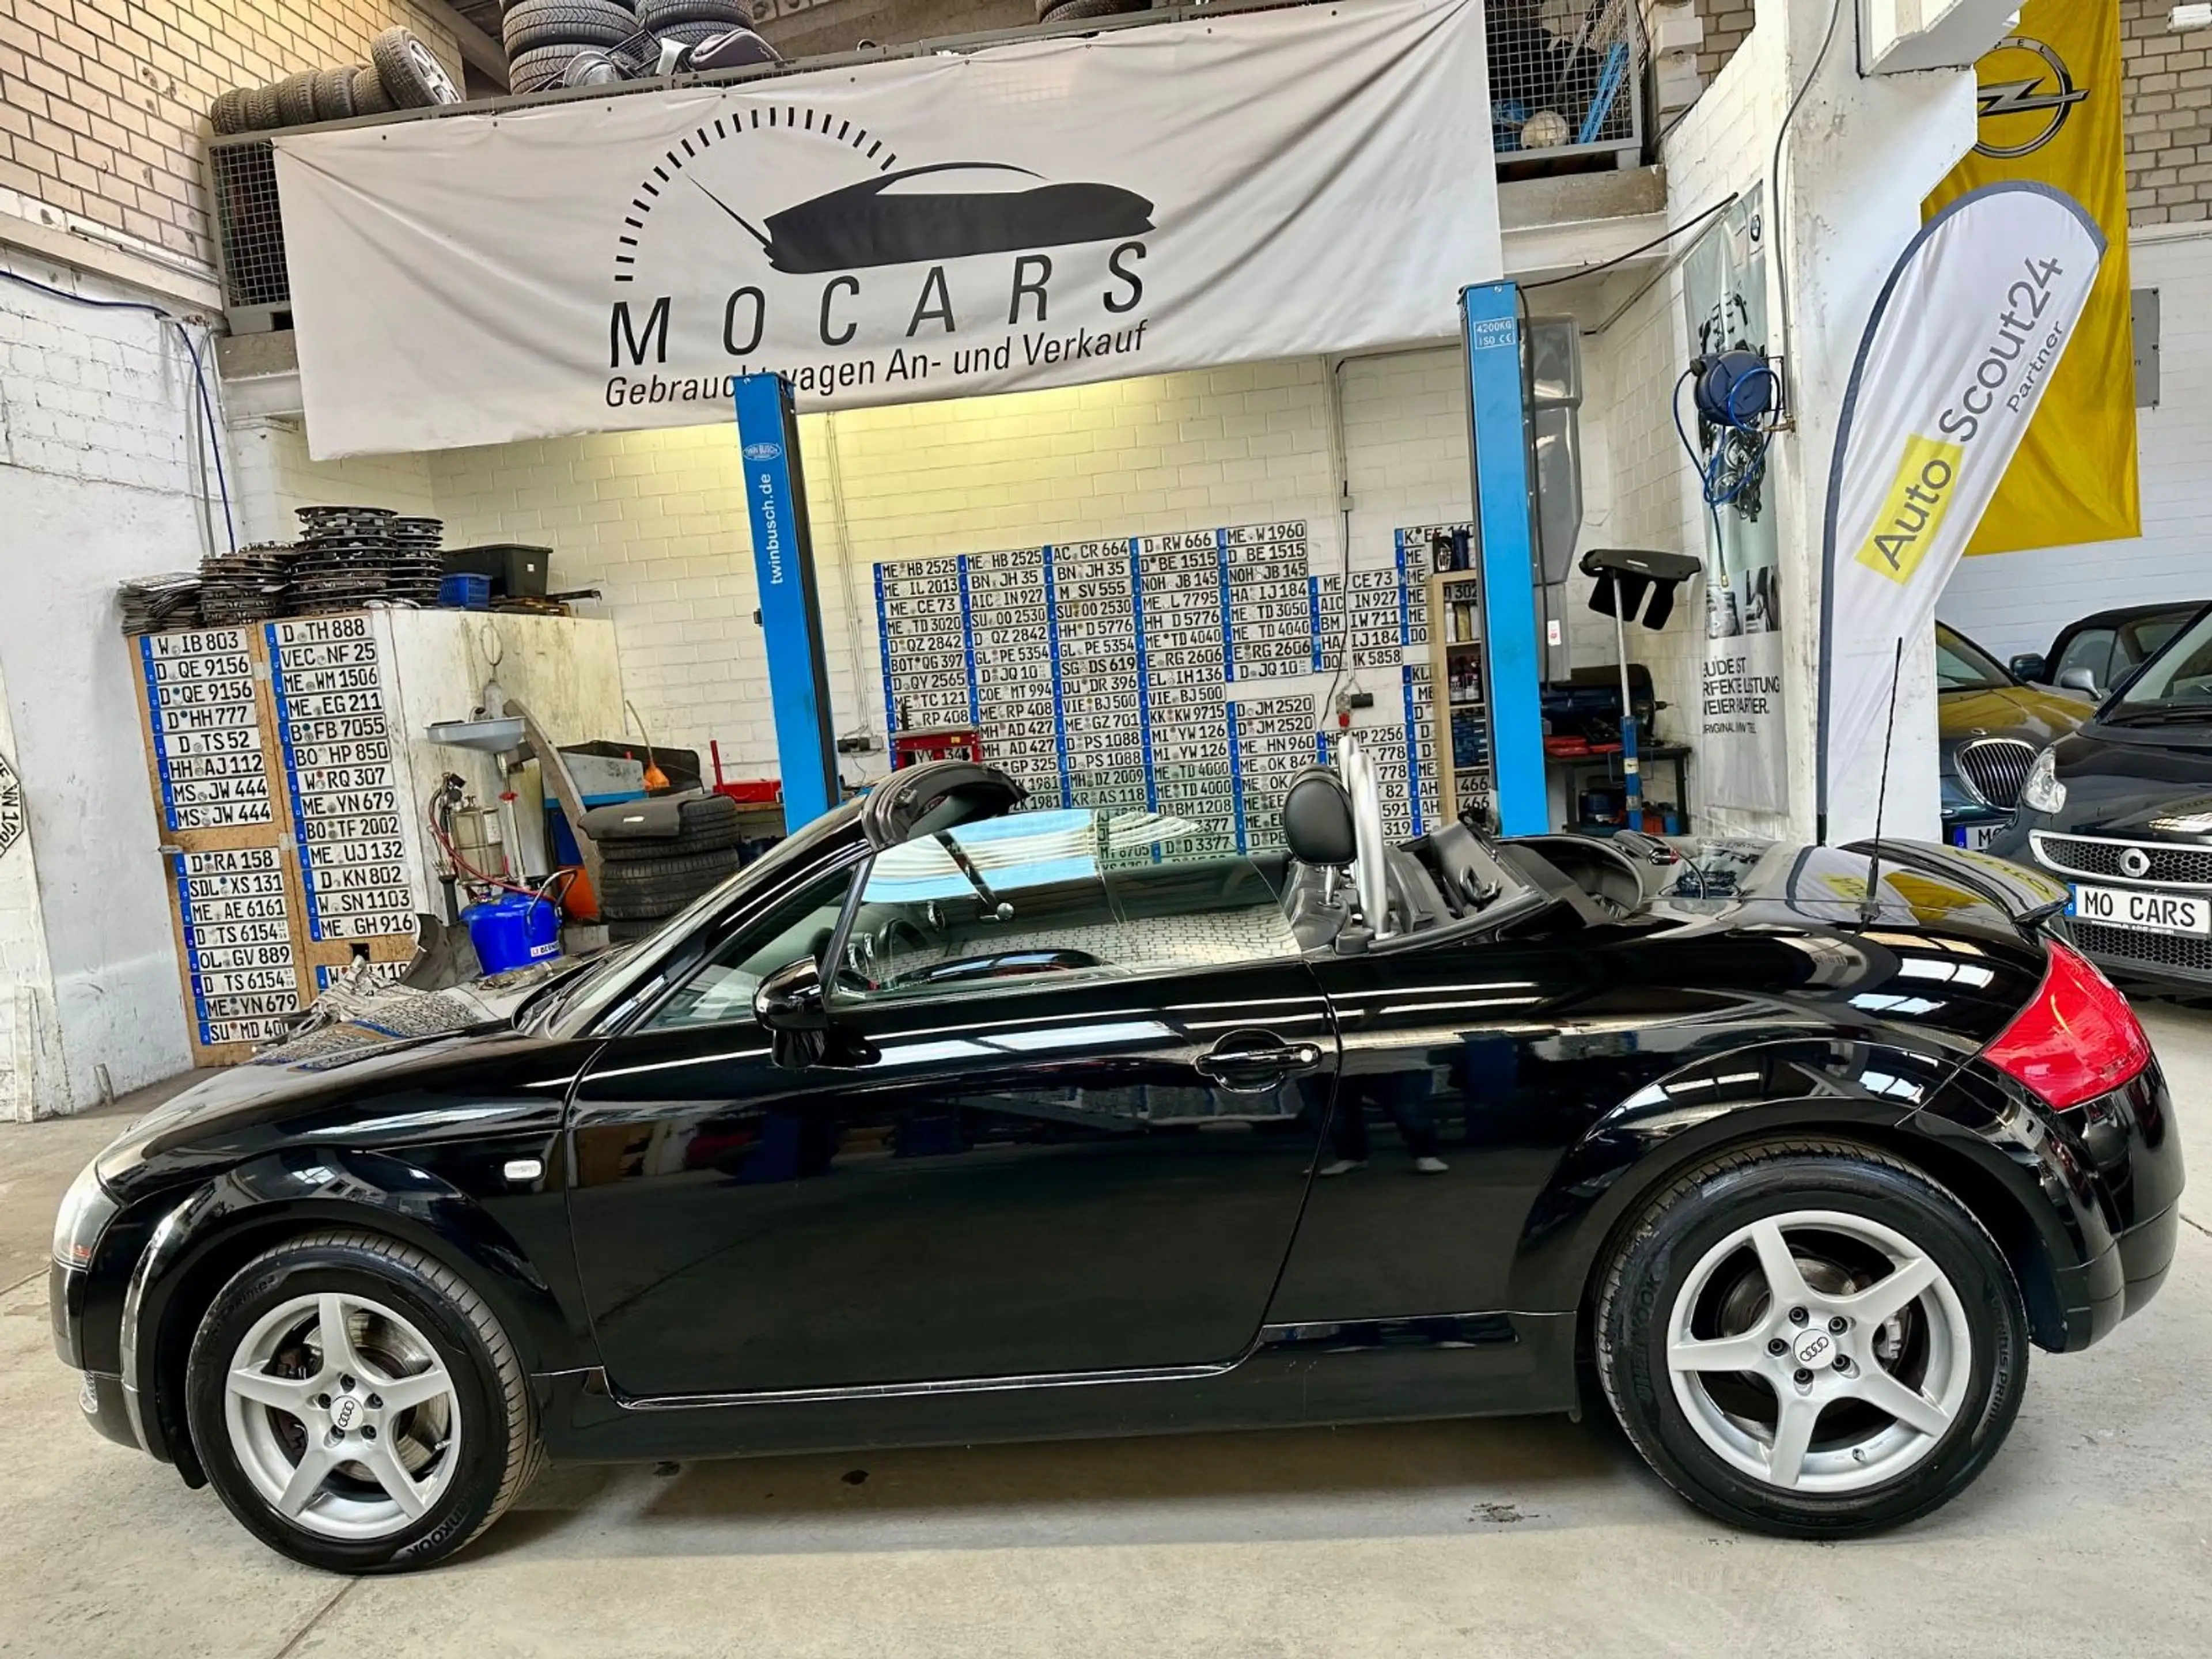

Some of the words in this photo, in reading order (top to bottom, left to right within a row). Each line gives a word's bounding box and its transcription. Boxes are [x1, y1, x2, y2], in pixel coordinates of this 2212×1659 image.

[1477, 321, 1512, 334] 4200KG
[886, 349, 941, 382] An-
[955, 336, 1010, 374] und
[1023, 319, 1149, 365] Verkauf
[1940, 255, 2063, 442] Scout24
[2007, 320, 2063, 413] Partner
[1873, 460, 1952, 571] Auto
[759, 474, 783, 584] twinbusch.de
[1054, 546, 1071, 561] AC
[1080, 544, 1099, 558] CR
[1103, 541, 1127, 556] 664
[1144, 539, 1153, 553] D
[1162, 536, 1181, 551] RW
[1185, 533, 1211, 548] 666
[1228, 550, 1237, 563] D
[1247, 547, 1266, 562] BE
[1269, 543, 1305, 559] 1515
[883, 565, 898, 578] ME
[907, 562, 923, 576] HB
[926, 559, 956, 574] 2525
[884, 583, 900, 597] ME
[910, 582, 924, 594] IL
[927, 578, 957, 593] 2013
[1060, 586, 1069, 599] M
[1078, 583, 1096, 597] SV
[1099, 580, 1126, 596] 555
[1142, 577, 1166, 591] NOH
[1175, 574, 1191, 588] JB
[1195, 571, 1217, 586] 145
[1324, 577, 1341, 592] ME
[1353, 574, 1372, 588] CE
[1374, 571, 1392, 586] 73
[972, 593, 993, 608] AIC
[1005, 591, 1018, 605] IN
[1021, 589, 1042, 603] 927
[1143, 596, 1161, 611] ME
[1171, 594, 1180, 607] L
[1183, 590, 1218, 607] 7795
[1230, 588, 1249, 603] HA
[1259, 585, 1277, 600] IJ
[1280, 582, 1306, 598] 184
[891, 602, 908, 616] ME
[918, 600, 935, 613] CE
[938, 598, 955, 612] 73
[282, 625, 294, 642] D
[305, 621, 329, 640] TH
[332, 619, 365, 638] 888
[158, 638, 168, 654] W
[182, 635, 202, 653] IB
[206, 631, 238, 650] 803
[889, 641, 897, 653] D
[907, 638, 925, 652] QZ
[928, 635, 961, 650] 2842
[281, 649, 316, 668] VEC
[327, 645, 349, 664] NF
[354, 642, 375, 661] 25
[892, 658, 913, 672] BOT
[940, 654, 963, 668] 397
[975, 651, 991, 665] GL
[1000, 649, 1016, 662] PE
[1018, 646, 1048, 661] 5354
[1062, 661, 1080, 675] SG
[1089, 659, 1107, 673] DS
[1110, 657, 1135, 671] 619
[156, 664, 167, 680] D
[178, 660, 202, 678] QE
[205, 656, 248, 676] 9156
[284, 674, 304, 692] ME
[315, 672, 336, 689] WM
[339, 667, 377, 687] 1506
[159, 688, 171, 705] D
[182, 685, 205, 703] QE
[209, 681, 252, 701] 9156
[288, 698, 312, 717] ME
[323, 696, 346, 714] EG
[349, 692, 382, 711] 211
[1150, 710, 1166, 724] KK
[1175, 709, 1190, 721] KW
[1194, 705, 1224, 720] 9715
[1237, 704, 1245, 717] D
[1256, 701, 1274, 715] JM
[1277, 698, 1311, 713] 2520
[167, 712, 179, 729] D
[190, 709, 213, 727] HH
[215, 706, 247, 725] 777
[290, 725, 302, 741] B
[314, 722, 338, 740] FB
[341, 717, 385, 737] 7055
[980, 725, 998, 738] MH
[1008, 724, 1025, 736] AD
[1029, 721, 1052, 734] 427
[179, 736, 190, 753] D
[200, 733, 225, 751] TS
[227, 731, 250, 748] 52
[1240, 740, 1258, 754] ME
[1267, 738, 1286, 752] HN
[1289, 736, 1315, 750] 960
[296, 748, 318, 766] BO
[329, 745, 351, 763] HP
[355, 742, 388, 760] 850
[169, 760, 192, 778] HH
[205, 757, 226, 775] AJ
[230, 755, 263, 773] 112
[304, 773, 315, 790] W
[327, 770, 350, 788] RQ
[354, 767, 385, 786] 307
[173, 785, 196, 802] MS
[209, 781, 229, 800] JW
[235, 779, 266, 797] 444
[302, 797, 326, 816] ME
[336, 794, 359, 812] YN
[363, 791, 394, 810] 679
[177, 809, 200, 827] MS
[212, 806, 233, 824] JW
[238, 804, 270, 822] 444
[191, 856, 203, 872] D
[214, 853, 237, 871] RA
[241, 850, 273, 869] 158
[190, 880, 219, 897] SDL
[230, 877, 250, 894] XS
[253, 874, 282, 892] 131
[192, 904, 213, 921] ME
[225, 902, 244, 919] AE
[247, 899, 285, 917] 6161
[2085, 891, 2113, 916] MO
[2130, 896, 2195, 927] CARS
[200, 952, 222, 968] OL
[233, 949, 253, 966] GV
[259, 946, 289, 964] 889
[206, 999, 230, 1017] ME
[240, 997, 263, 1014] YN
[267, 994, 296, 1012] 679
